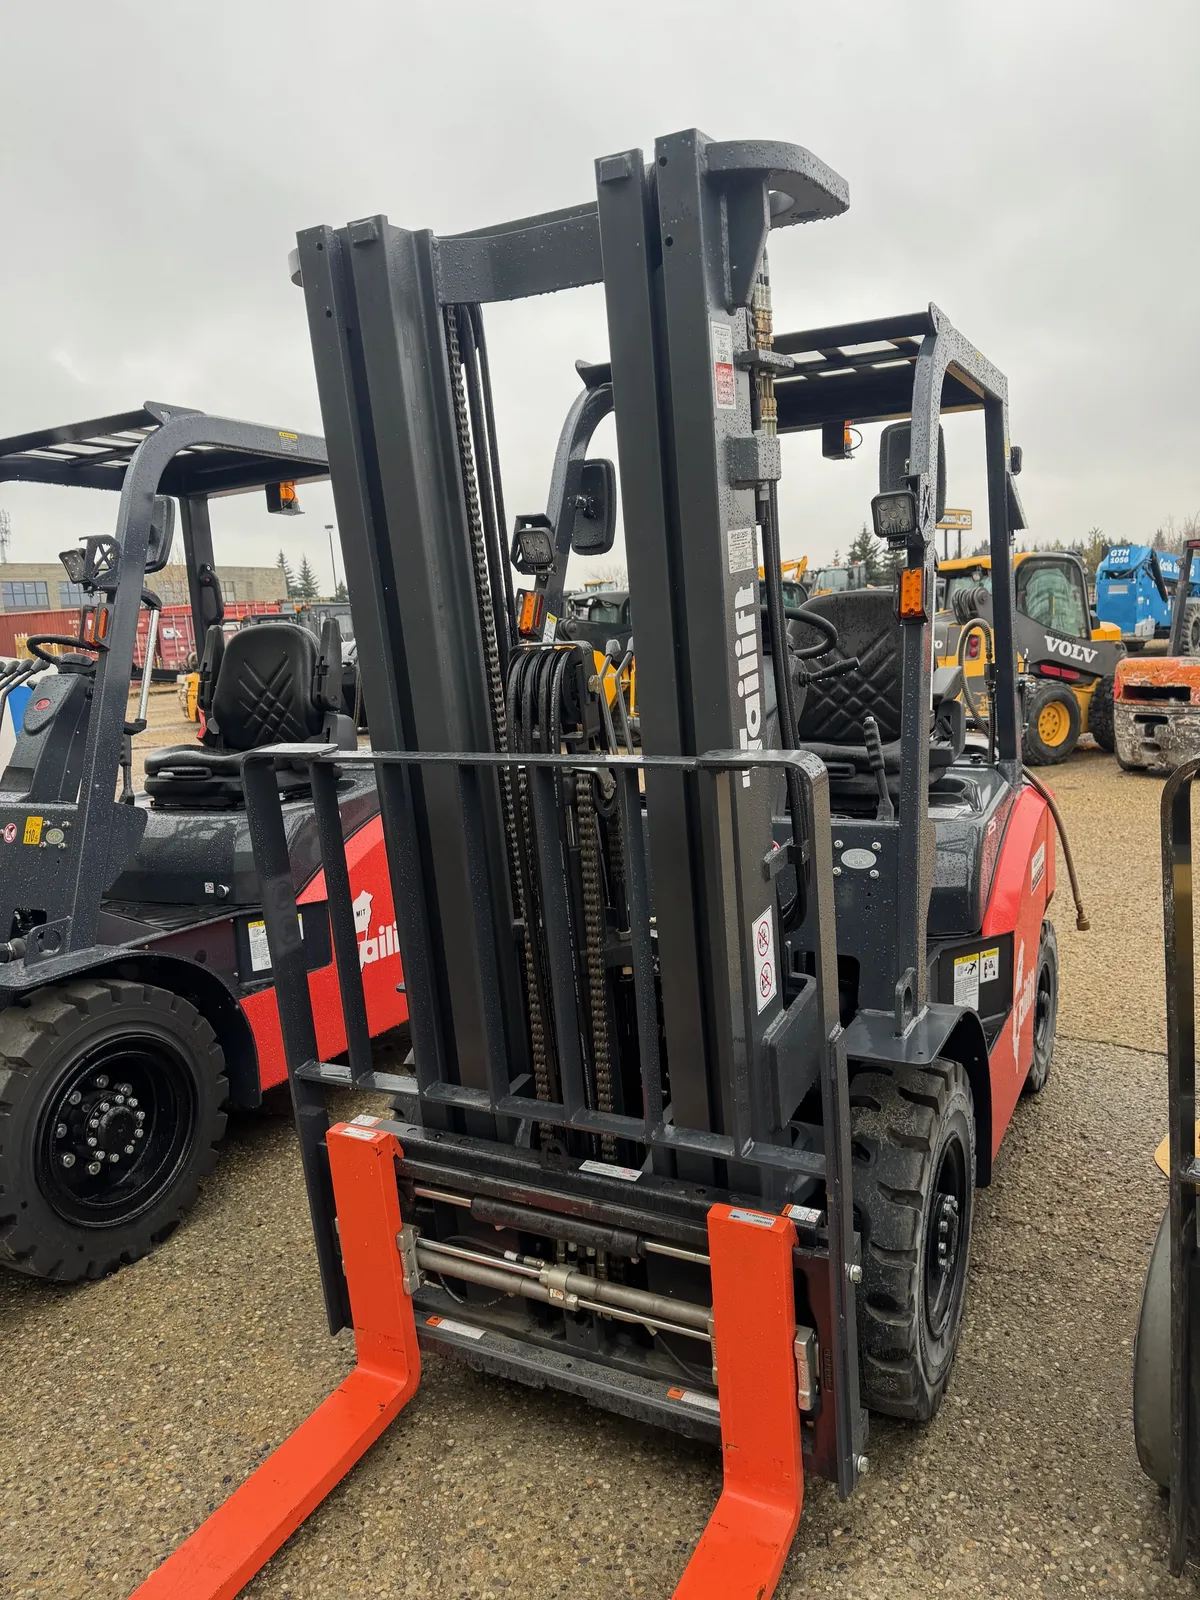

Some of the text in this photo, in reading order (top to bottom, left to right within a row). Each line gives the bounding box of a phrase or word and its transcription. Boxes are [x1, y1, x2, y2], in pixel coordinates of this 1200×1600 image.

[957, 514, 971, 525] JCB
[1110, 549, 1130, 557] GTH
[356, 908, 366, 917] MIT
